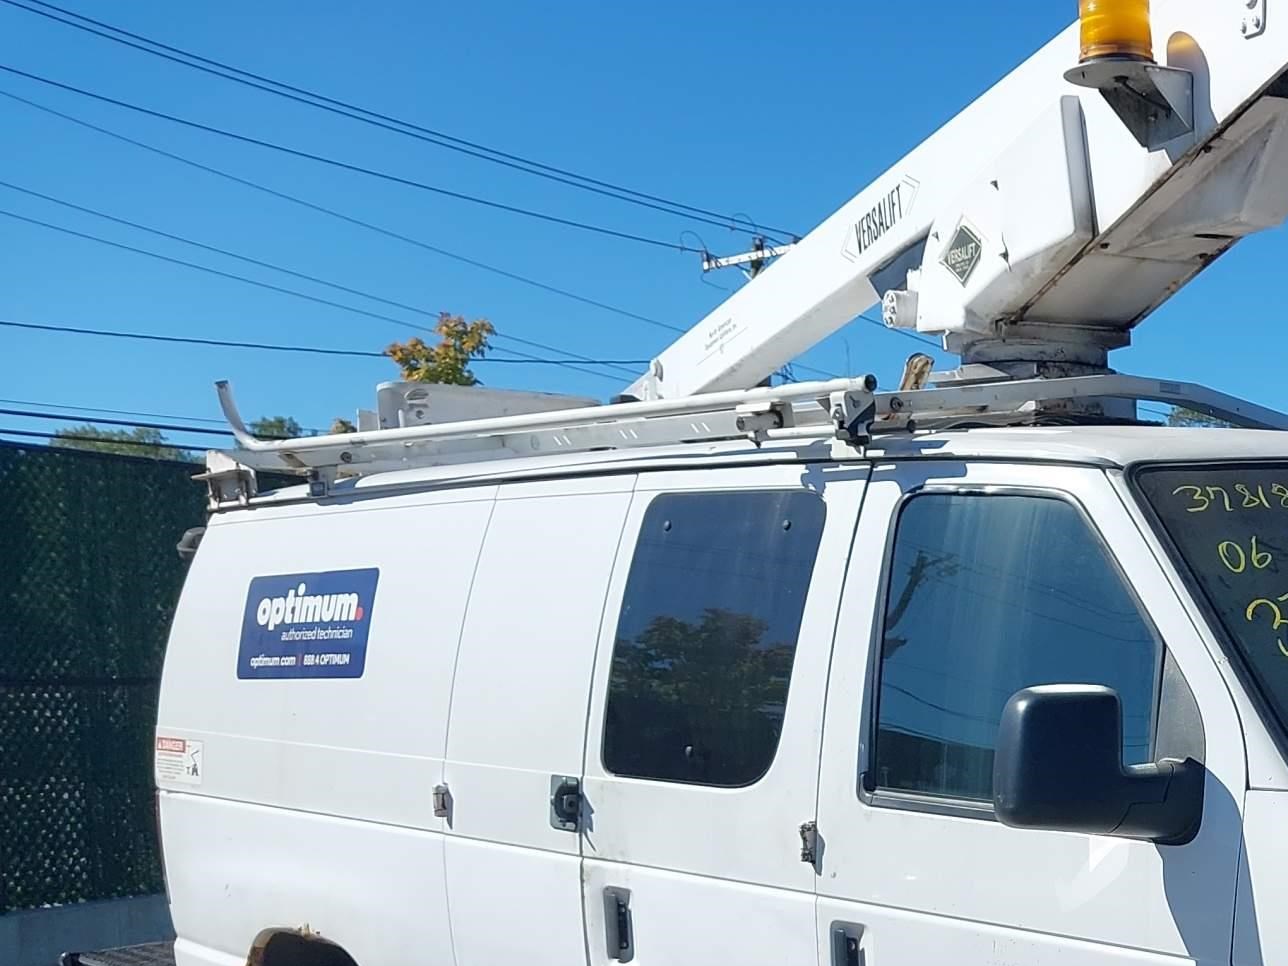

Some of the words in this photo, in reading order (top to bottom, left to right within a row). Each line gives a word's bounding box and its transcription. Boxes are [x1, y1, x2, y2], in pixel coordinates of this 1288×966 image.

[855, 183, 902, 255] VERSALIFT
[947, 242, 976, 266] VERSALIFT
[1217, 536, 1273, 573] 06
[281, 627, 317, 641] authorized
[318, 626, 353, 640] technician
[250, 654, 296, 669] optimum.com
[320, 654, 350, 665] OPTIMUM
